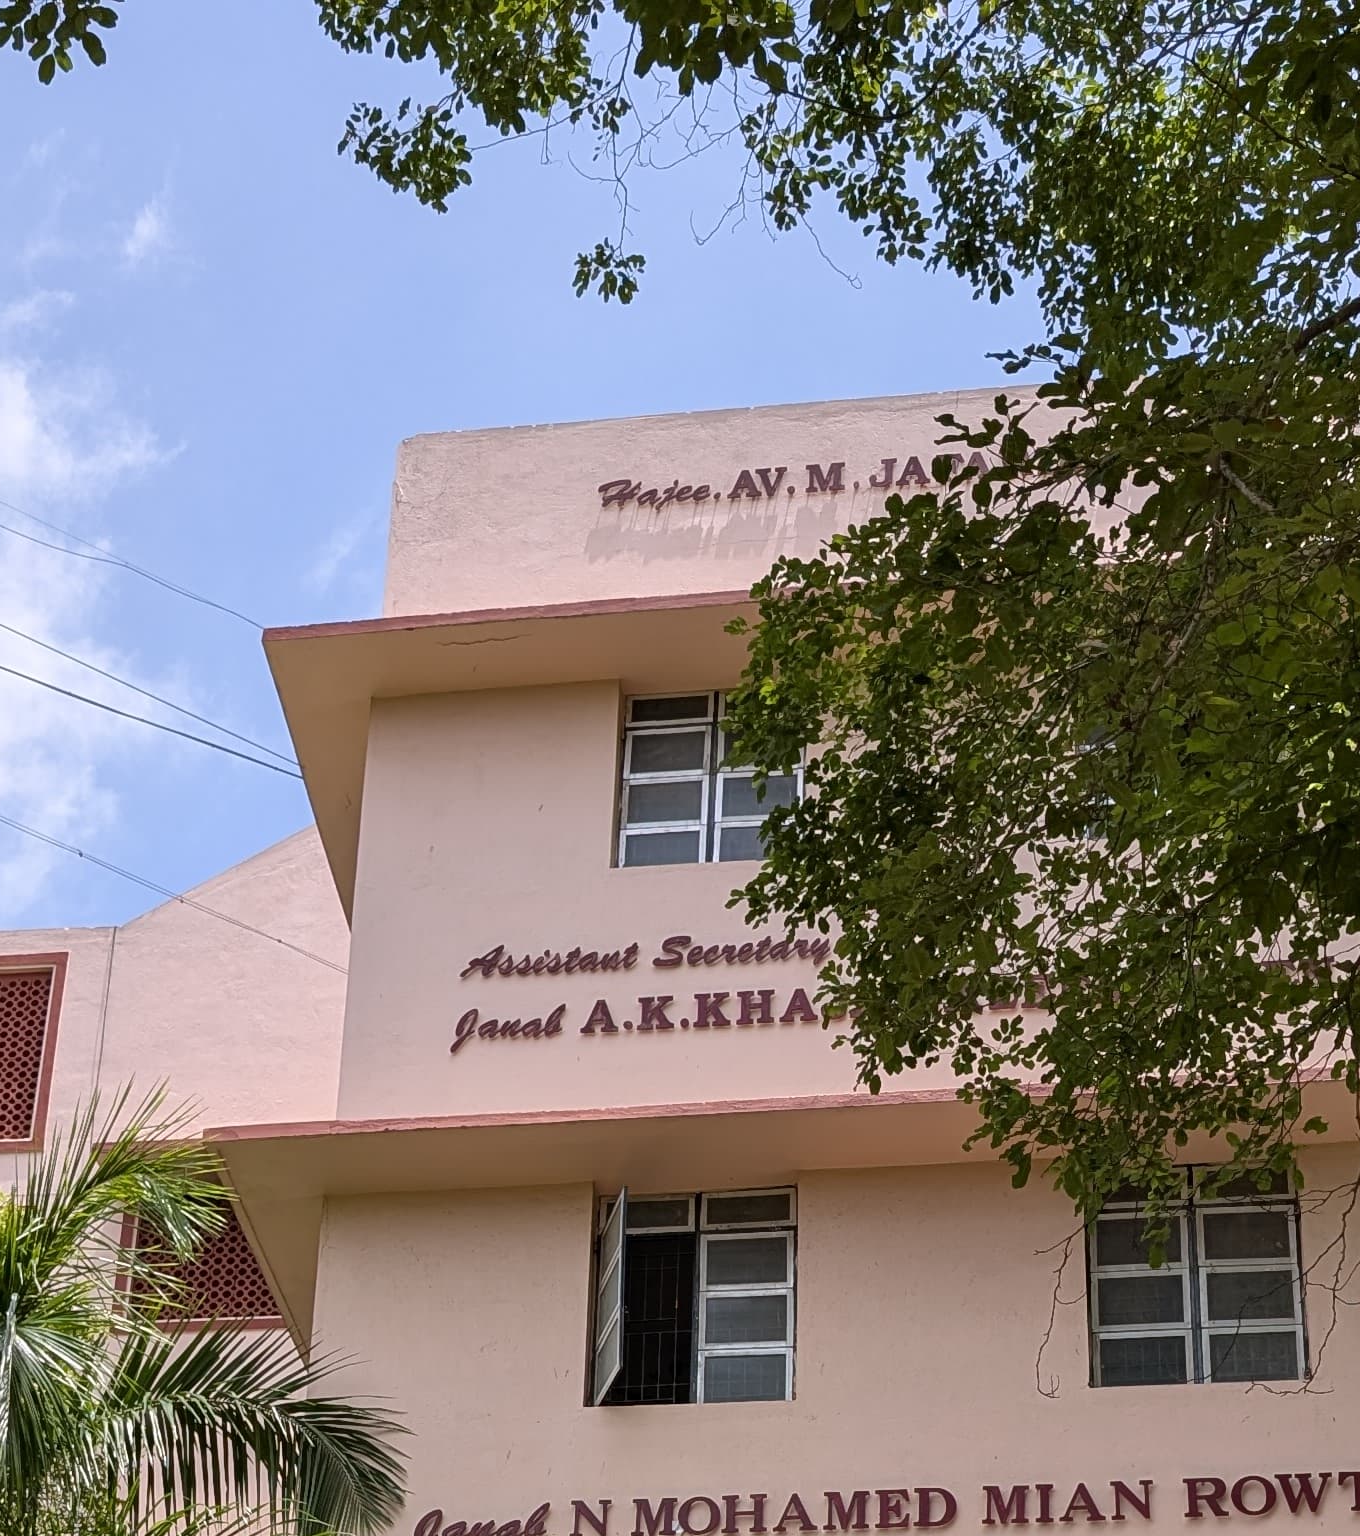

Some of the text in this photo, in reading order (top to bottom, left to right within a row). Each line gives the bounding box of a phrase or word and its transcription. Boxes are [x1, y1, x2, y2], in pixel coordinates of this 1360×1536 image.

[460, 935, 832, 978] Assistant Secretary
[450, 1002, 567, 1054] Janab
[981, 1480, 1155, 1526] MIAN
